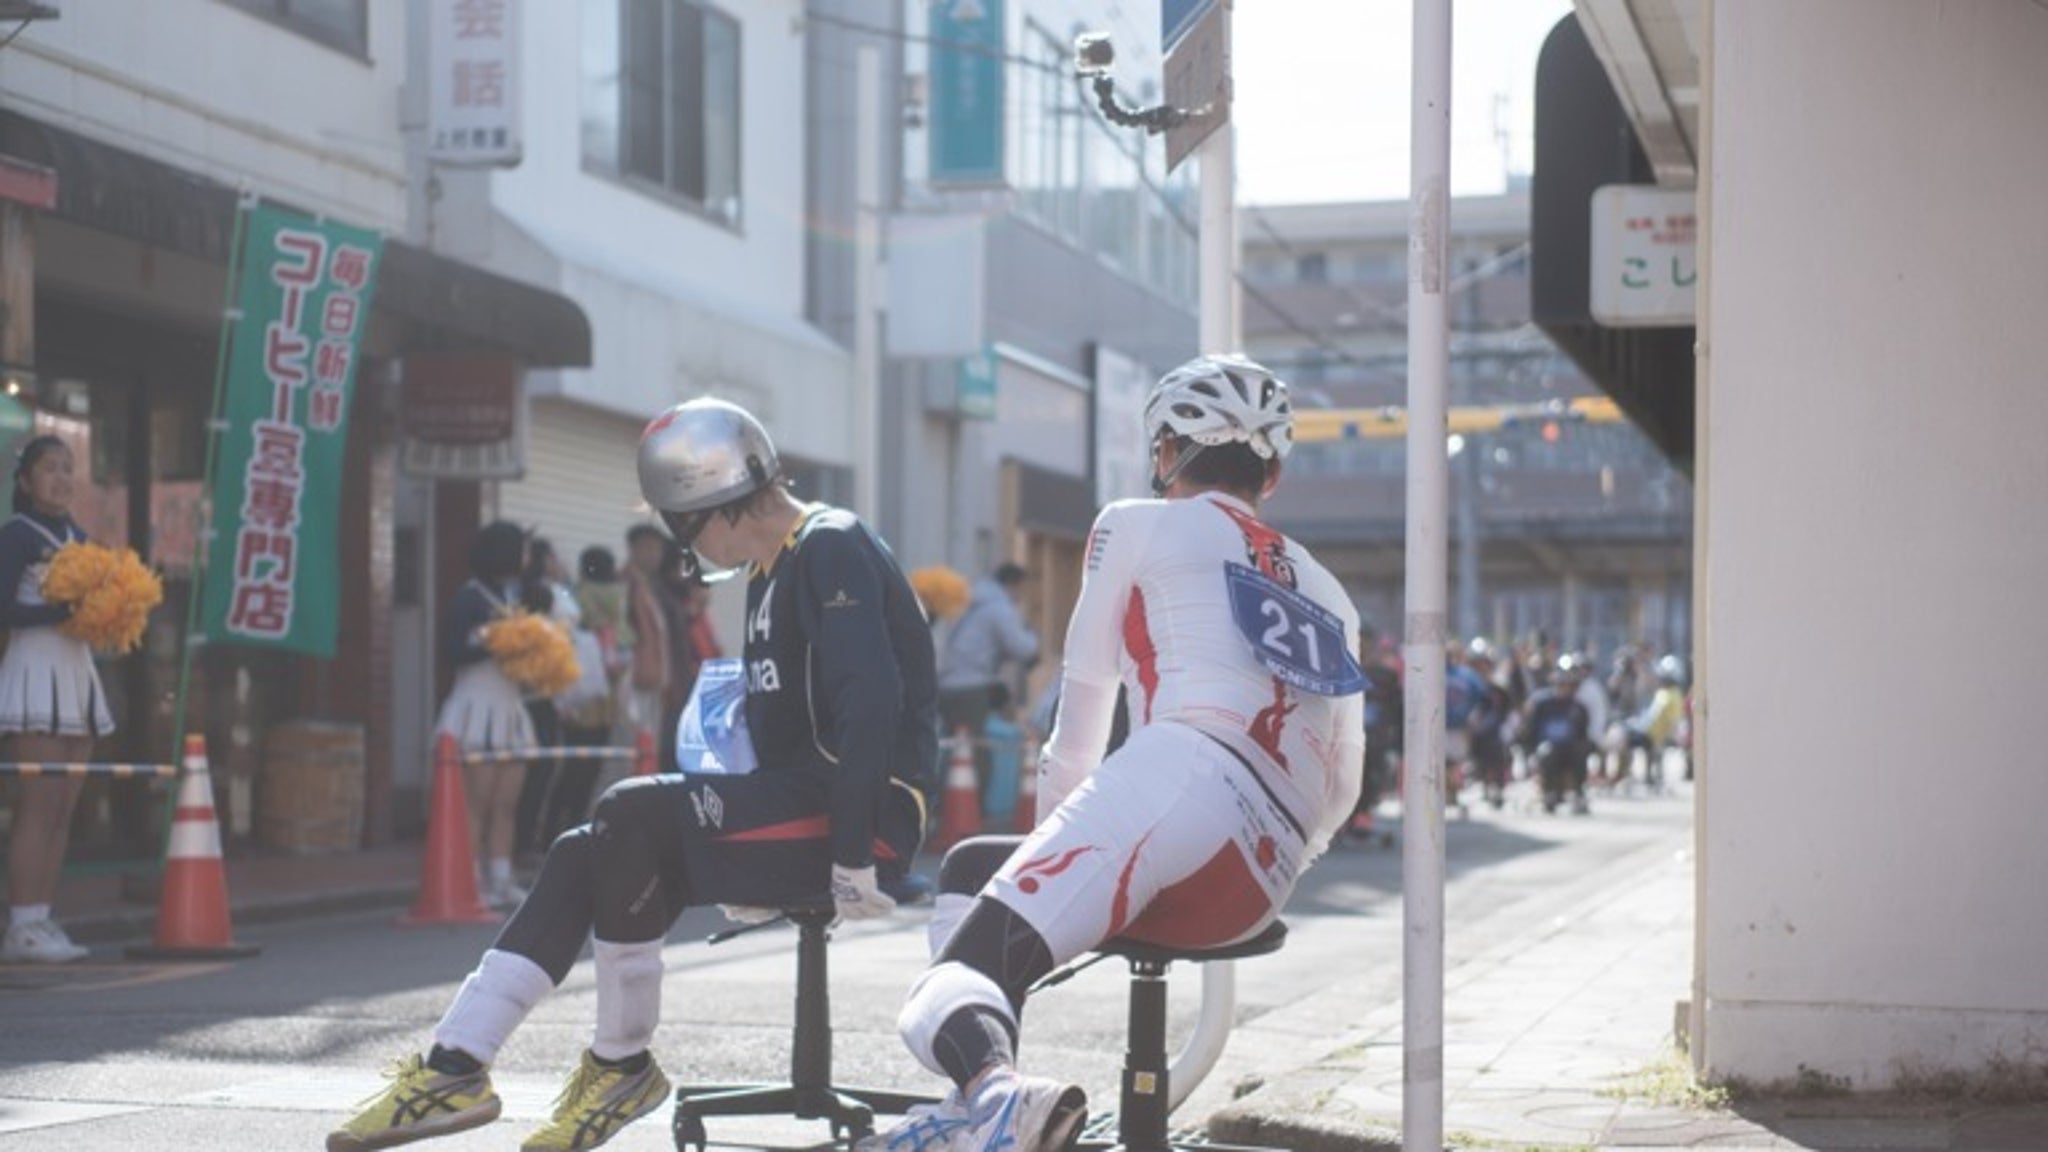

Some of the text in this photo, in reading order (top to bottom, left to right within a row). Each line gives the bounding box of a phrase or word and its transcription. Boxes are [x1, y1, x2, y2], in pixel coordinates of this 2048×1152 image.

[1621, 256, 1697, 288] こし
[307, 244, 372, 433] 毎日新鮮
[228, 231, 325, 637] コーヒー豆専門店
[1260, 599, 1321, 673] 21
